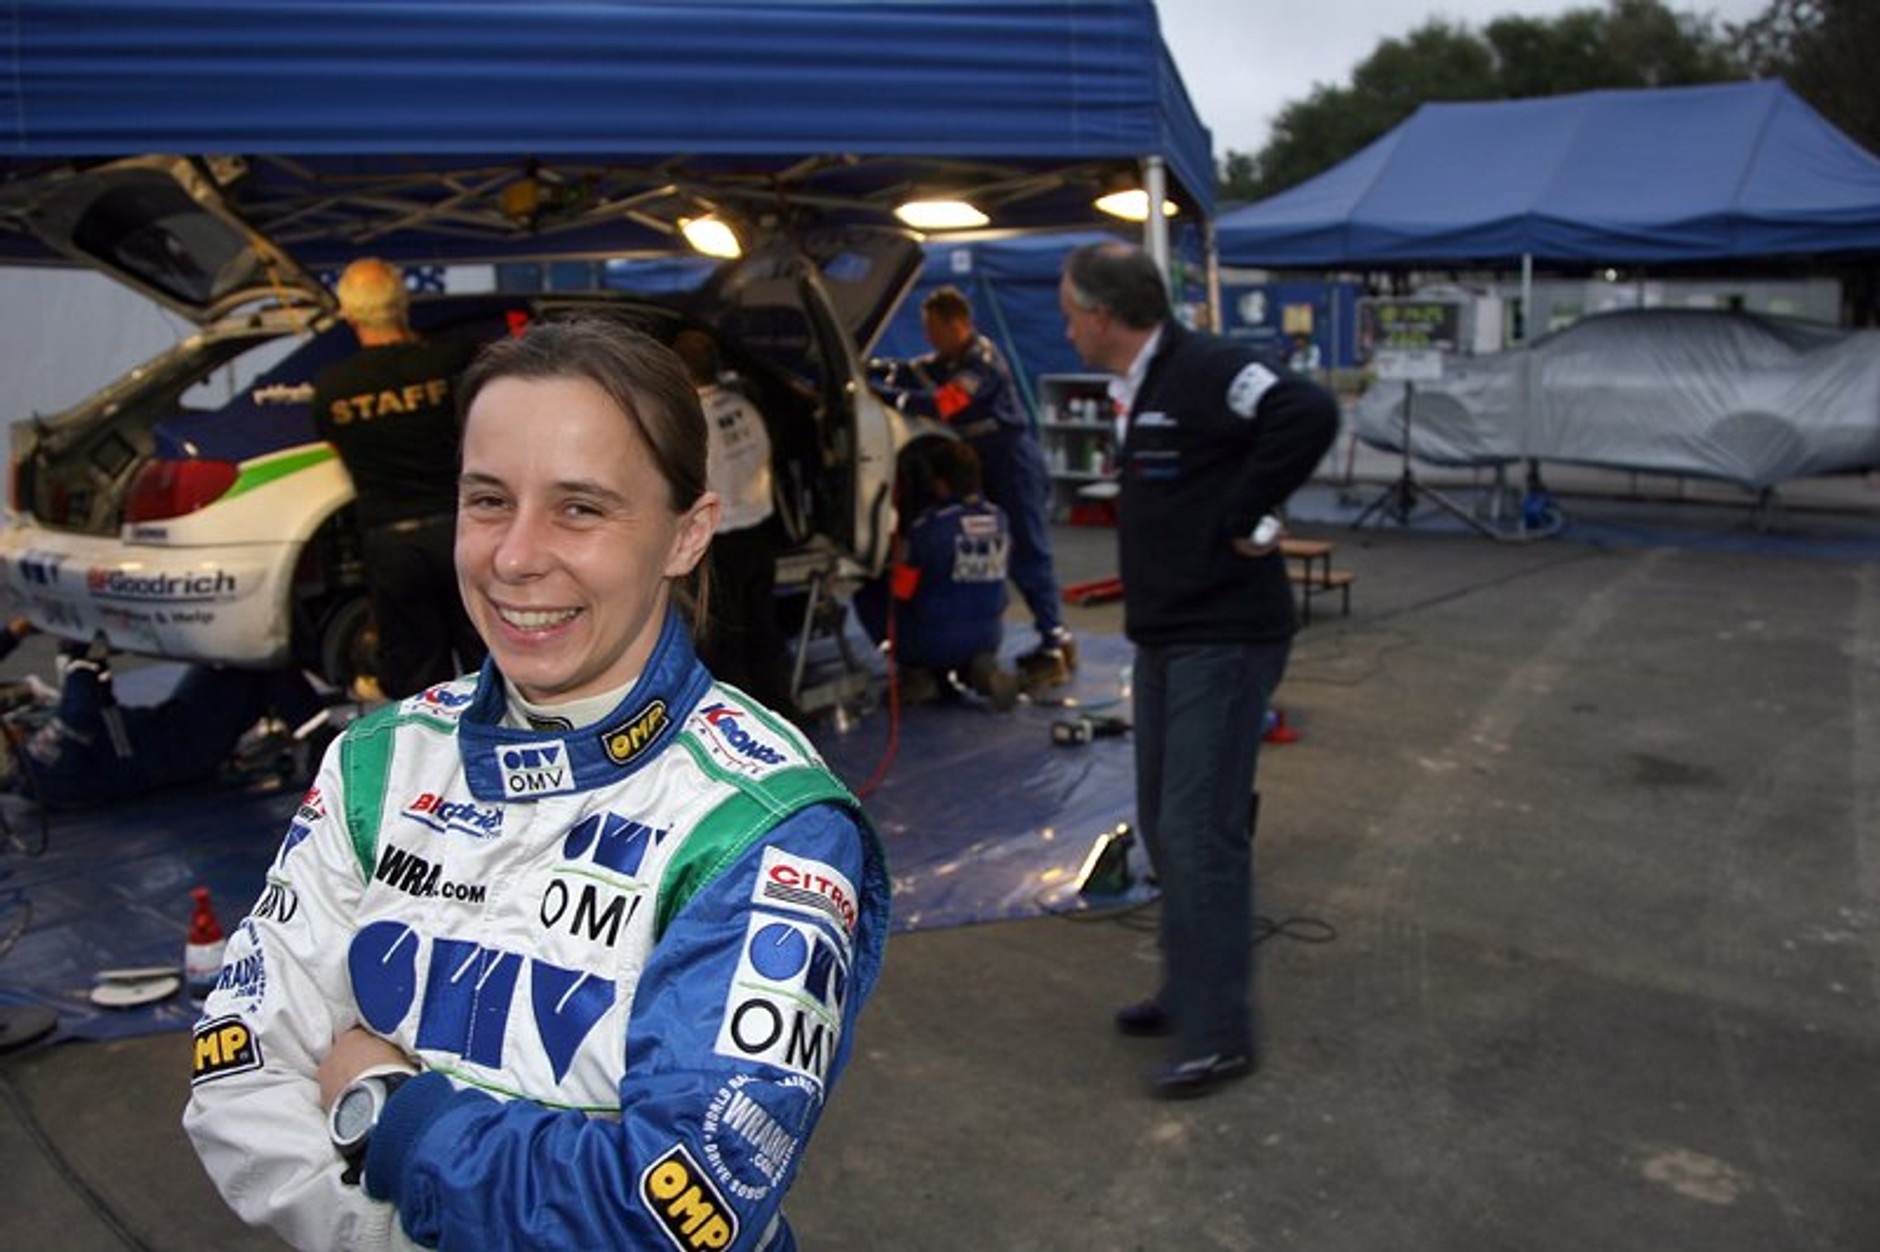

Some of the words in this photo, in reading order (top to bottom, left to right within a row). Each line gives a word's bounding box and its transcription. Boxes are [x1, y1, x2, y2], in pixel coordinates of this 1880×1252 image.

[329, 378, 447, 425] STAFF
[611, 705, 664, 758] OMP
[509, 769, 563, 792] OMV
[193, 1025, 248, 1071] MP
[649, 1159, 730, 1249] OMP
